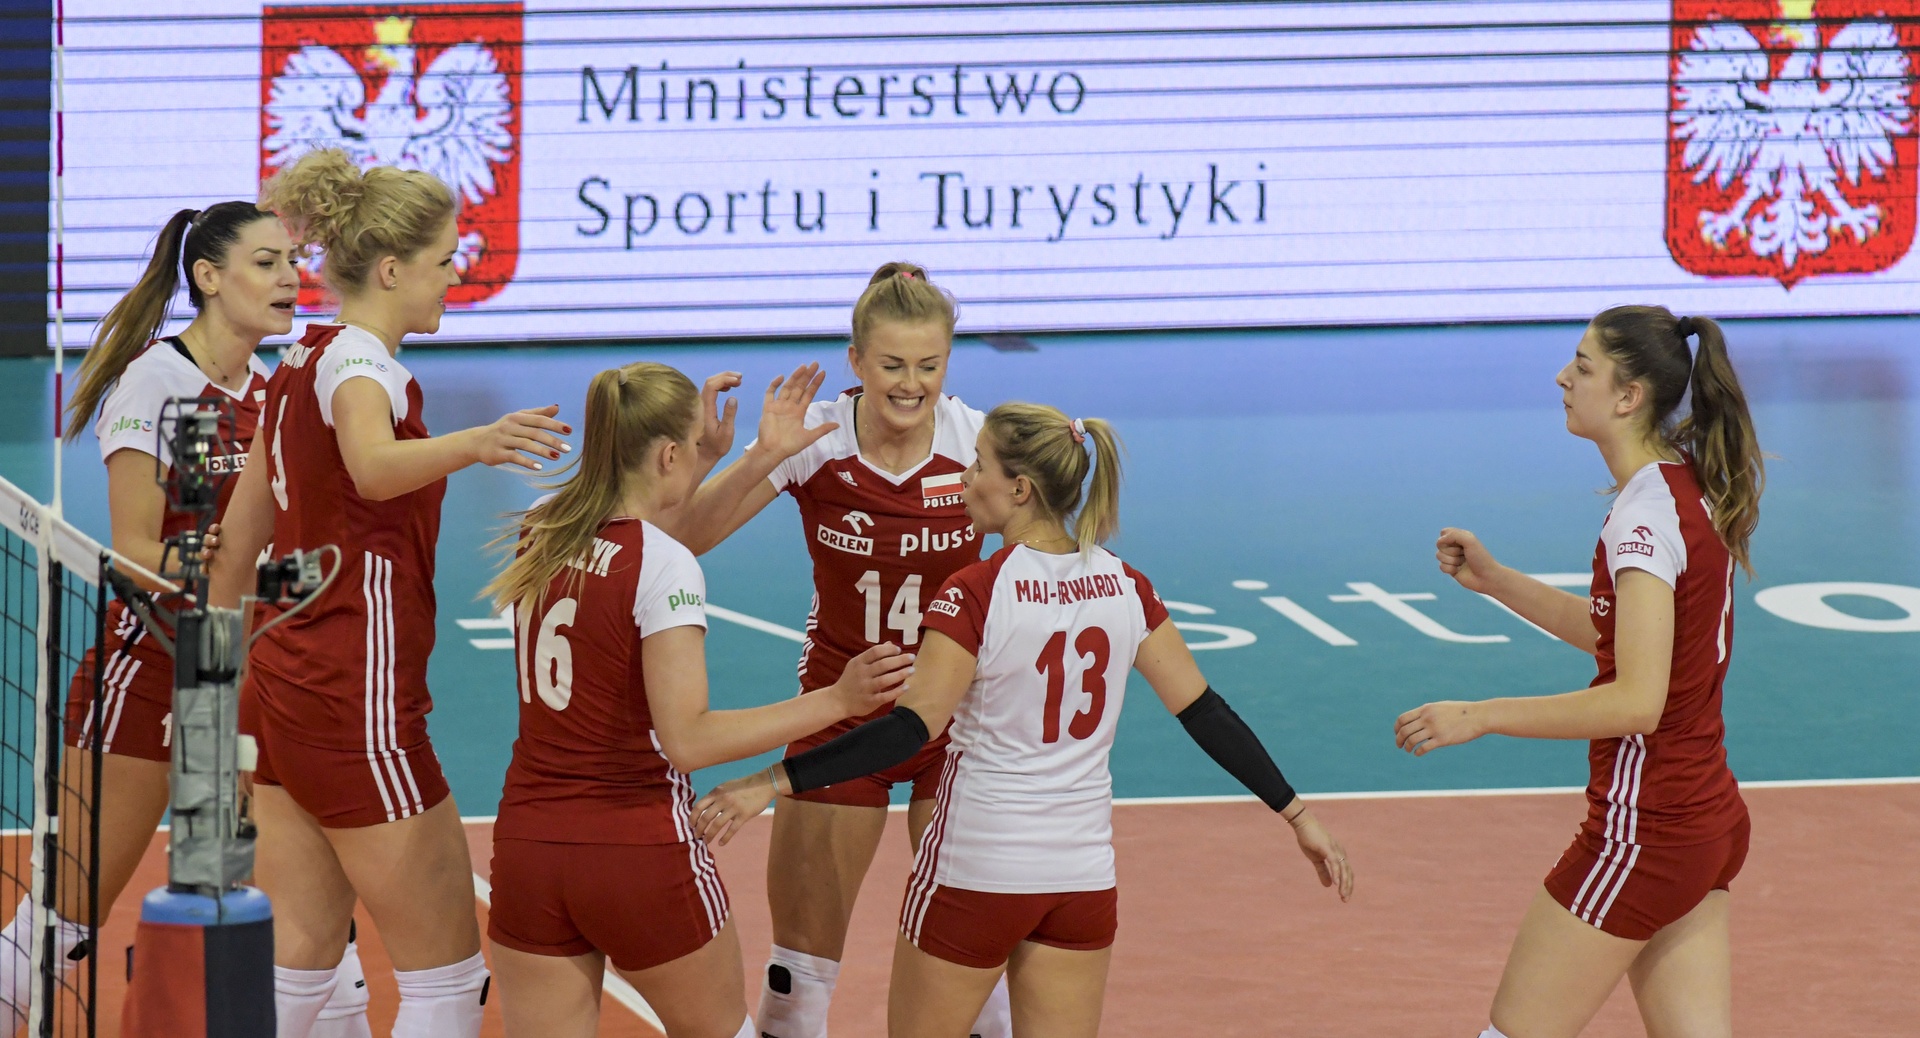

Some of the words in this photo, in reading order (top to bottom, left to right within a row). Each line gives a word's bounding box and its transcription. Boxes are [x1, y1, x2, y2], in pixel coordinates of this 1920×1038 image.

[578, 57, 1085, 122] Ministerstwo
[577, 174, 827, 250] Sportu
[868, 169, 880, 230] i
[919, 161, 1266, 241] Turystyki
[334, 357, 374, 375] plus
[111, 415, 141, 437] plus
[923, 494, 964, 508] POLSK
[820, 529, 869, 552] ORLEN
[899, 527, 962, 557] plus
[1618, 543, 1652, 555] ORLEN
[668, 588, 702, 611] plus
[854, 570, 924, 646] 14
[515, 597, 577, 711] 16
[1035, 625, 1111, 744] 13
